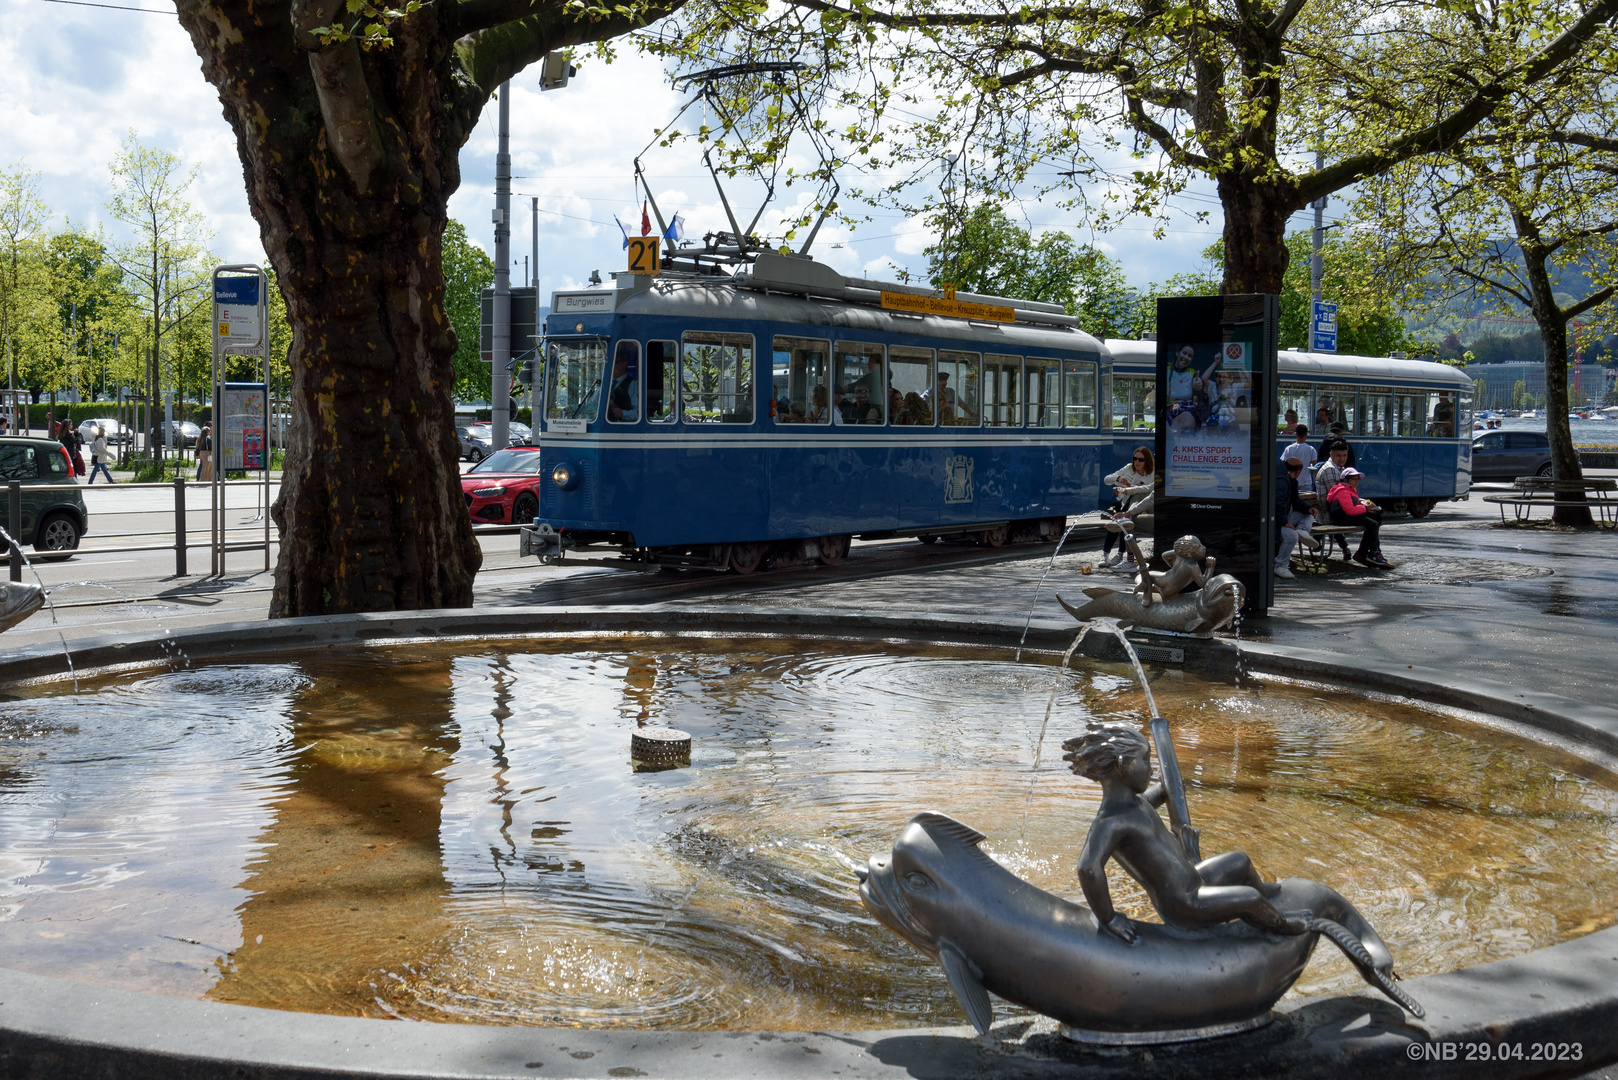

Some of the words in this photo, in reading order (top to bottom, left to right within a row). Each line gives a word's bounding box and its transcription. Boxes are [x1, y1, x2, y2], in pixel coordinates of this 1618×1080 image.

[630, 240, 657, 271] 21
[566, 297, 605, 308] Burgwies
[885, 294, 926, 309] Hauptbahnhof
[930, 301, 953, 312] Bellevue
[957, 304, 985, 317] Kreuzplatz
[989, 308, 1013, 320] Burgwies
[223, 310, 229, 319] E
[1172, 455, 1219, 463] CHALLENGE
[1221, 456, 1243, 464] 2023
